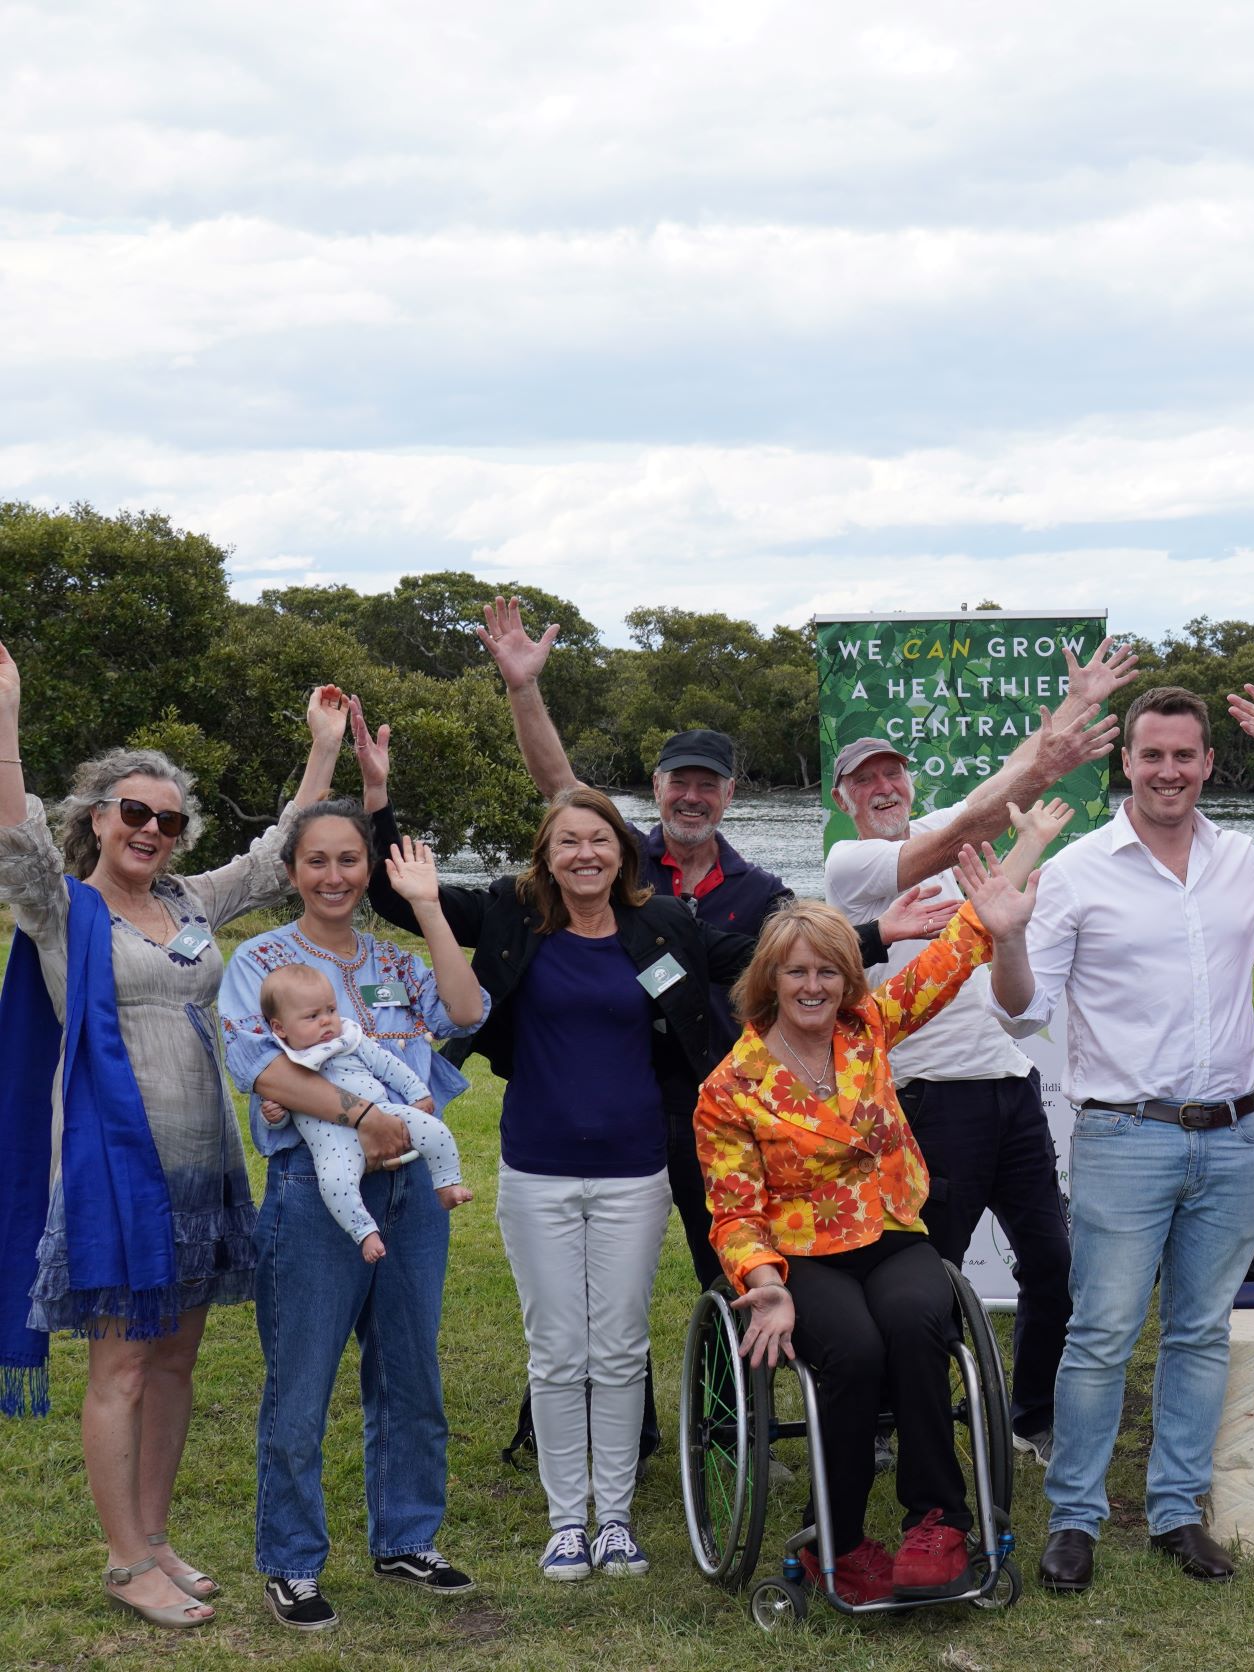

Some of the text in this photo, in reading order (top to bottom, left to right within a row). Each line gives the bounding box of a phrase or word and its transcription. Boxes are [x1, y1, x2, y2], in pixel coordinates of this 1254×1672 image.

[838, 636, 1085, 660] WE CAN GROW
[851, 676, 1070, 699] A HEALTHIER
[886, 716, 1034, 738] CENTRAL
